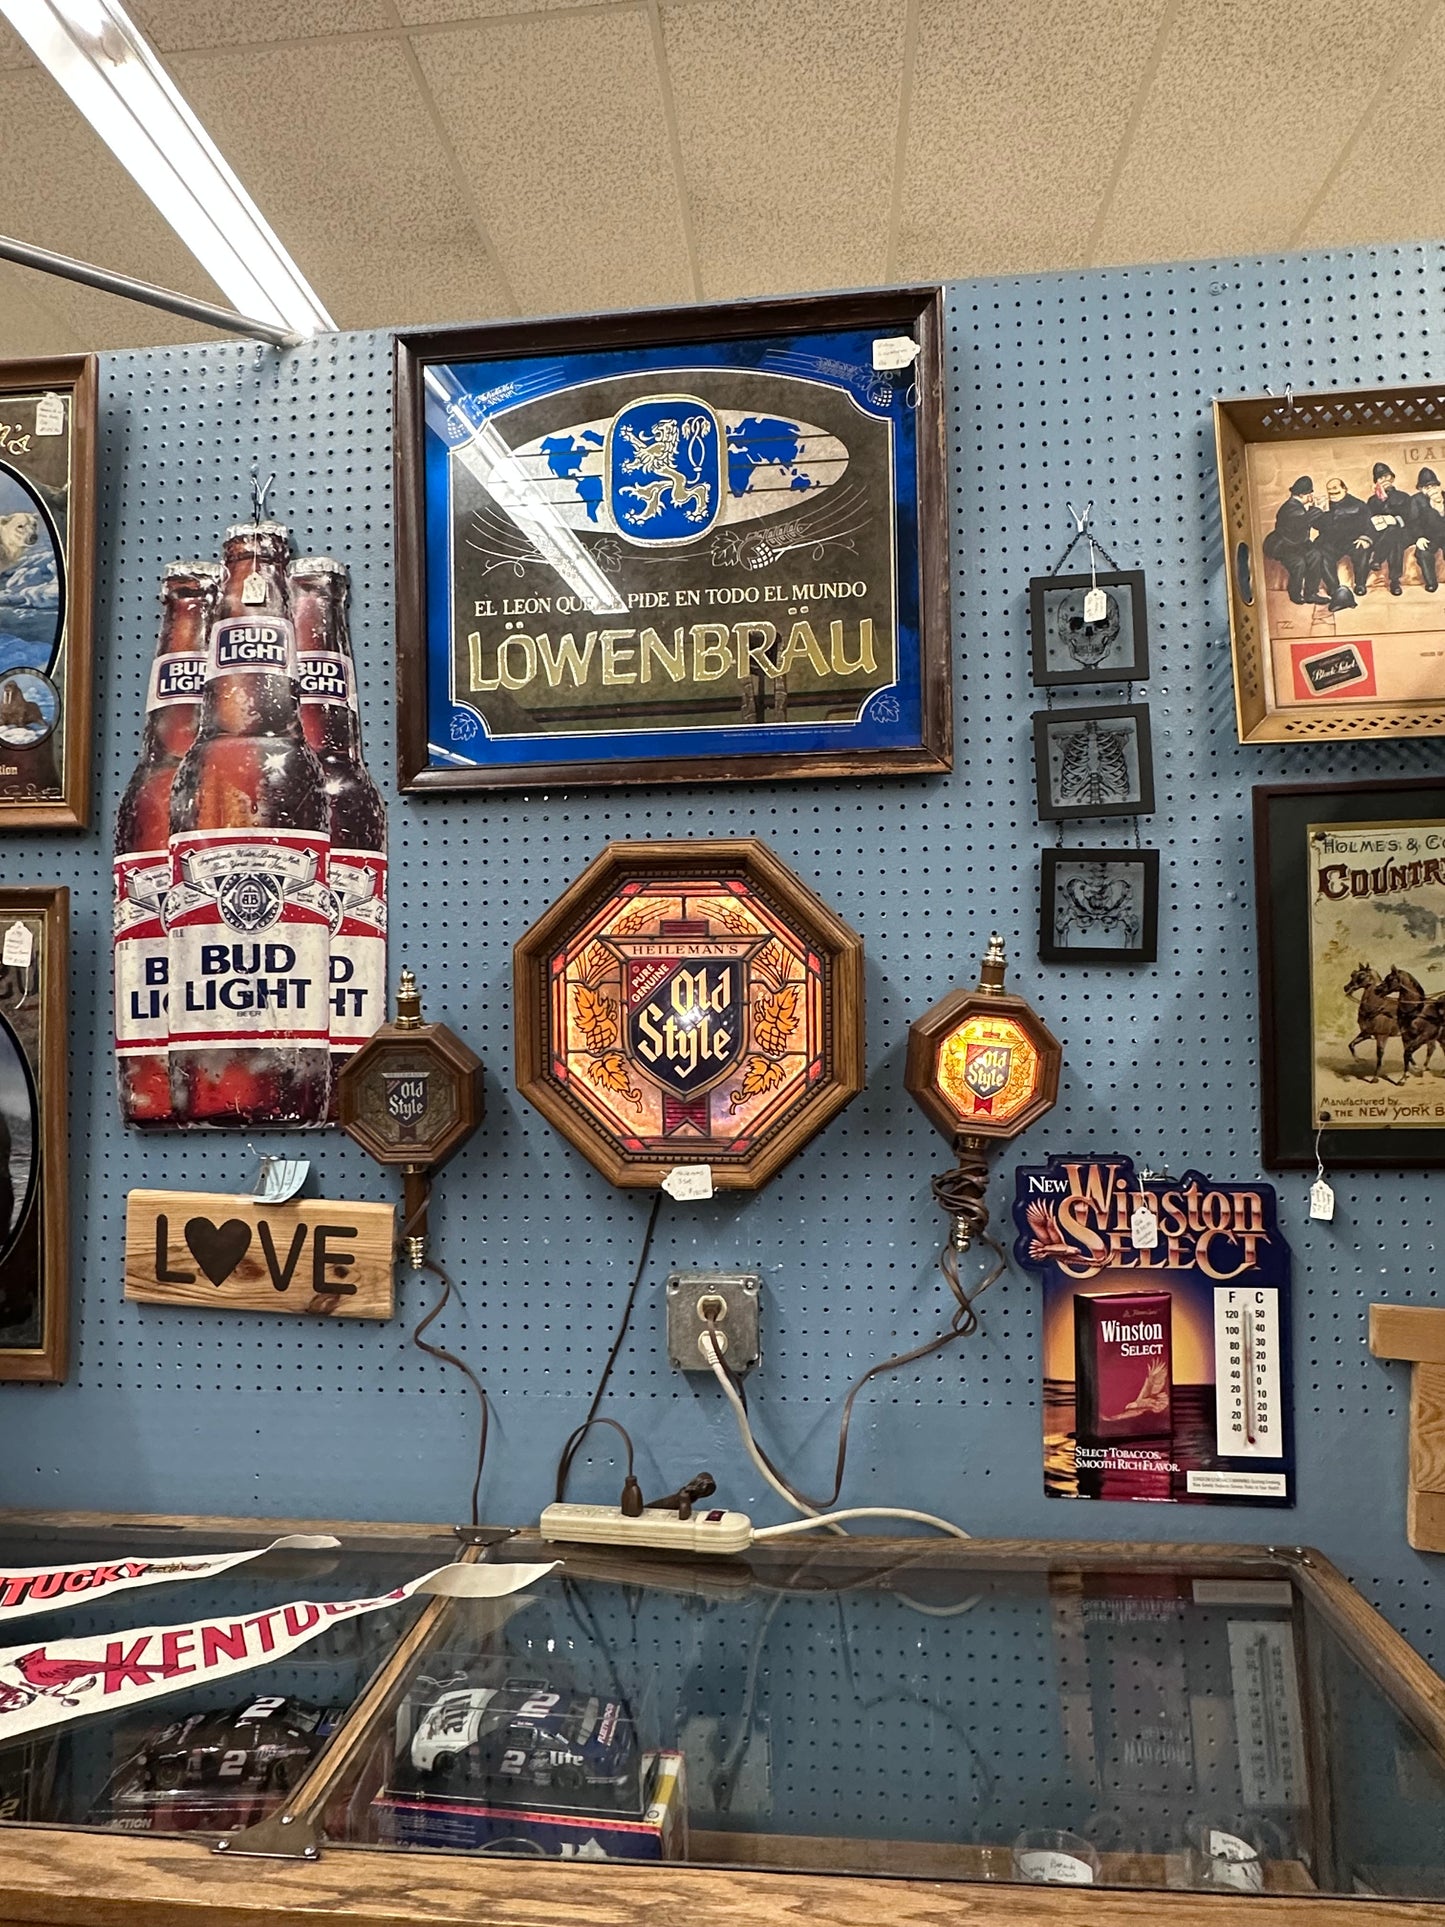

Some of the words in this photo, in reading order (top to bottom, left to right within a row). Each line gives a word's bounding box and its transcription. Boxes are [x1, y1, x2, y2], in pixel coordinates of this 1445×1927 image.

[474, 600, 498, 617] EL
[628, 591, 670, 609] PIDE
[675, 590, 700, 606] EN
[705, 587, 760, 604] TODO
[764, 585, 789, 602] EL
[792, 581, 867, 600] MUNDO
[229, 628, 278, 644] BUD
[219, 645, 286, 661] LIGHT
[468, 605, 878, 692] LÖWENBRÄU
[1406, 837, 1419, 855] &
[632, 944, 739, 955] HEILEMAN'S
[201, 943, 296, 975] BUD
[631, 963, 656, 988] PURE
[631, 963, 670, 1003] GENUINE
[185, 978, 312, 1012] LIGHT
[671, 965, 732, 1017] Old
[637, 1002, 732, 1079] Style
[983, 1050, 1008, 1069] Old
[966, 1061, 1005, 1093] Style
[400, 1081, 424, 1099] Old
[388, 1094, 425, 1120] Style
[1320, 1097, 1386, 1109] Manufactured
[1387, 1097, 1401, 1107] by
[1335, 1109, 1354, 1117] THE
[1359, 1106, 1389, 1117] NEW
[1393, 1106, 1431, 1120] YORK
[1028, 1176, 1069, 1194] NEW
[1060, 1163, 1268, 1238] Winston
[1057, 1194, 1272, 1281] SELECT
[1228, 1291, 1236, 1303] F
[1255, 1291, 1264, 1304] C
[1225, 1310, 1239, 1319] 120
[1255, 1309, 1265, 1318] 50
[1101, 1320, 1163, 1343] Winston
[1225, 1326, 1239, 1335] 100
[1255, 1323, 1266, 1333] 40
[1229, 1341, 1240, 1350] 80
[1255, 1337, 1266, 1347] 30
[1120, 1343, 1164, 1357] SELECT
[1255, 1351, 1266, 1360] 20
[1230, 1356, 1240, 1365] 60
[1230, 1370, 1241, 1379] 40
[1256, 1364, 1266, 1373] 10
[1256, 1376, 1262, 1386] 0
[1230, 1384, 1241, 1393] 20
[1257, 1390, 1267, 1399] 10
[1235, 1398, 1241, 1407] 0
[1257, 1402, 1268, 1411] 20
[1231, 1410, 1242, 1420] 20
[1257, 1414, 1268, 1423] 30
[1231, 1423, 1242, 1433] 40
[1257, 1425, 1268, 1434] 40
[1075, 1446, 1108, 1458] SELECT
[1109, 1447, 1162, 1460] TOBACCOS.
[1075, 1457, 1116, 1469] SMOOTH
[1117, 1459, 1142, 1470] RICH
[1143, 1460, 1181, 1472] FLAVOR.
[0, 1562, 151, 1606] TUCKY
[103, 1587, 406, 1694] KENTUC
[239, 1696, 286, 1718] 2
[518, 1692, 561, 1718] 2
[218, 1750, 248, 1776] 2
[500, 1749, 527, 1775] 2
[111, 1817, 153, 1830] ACTION
